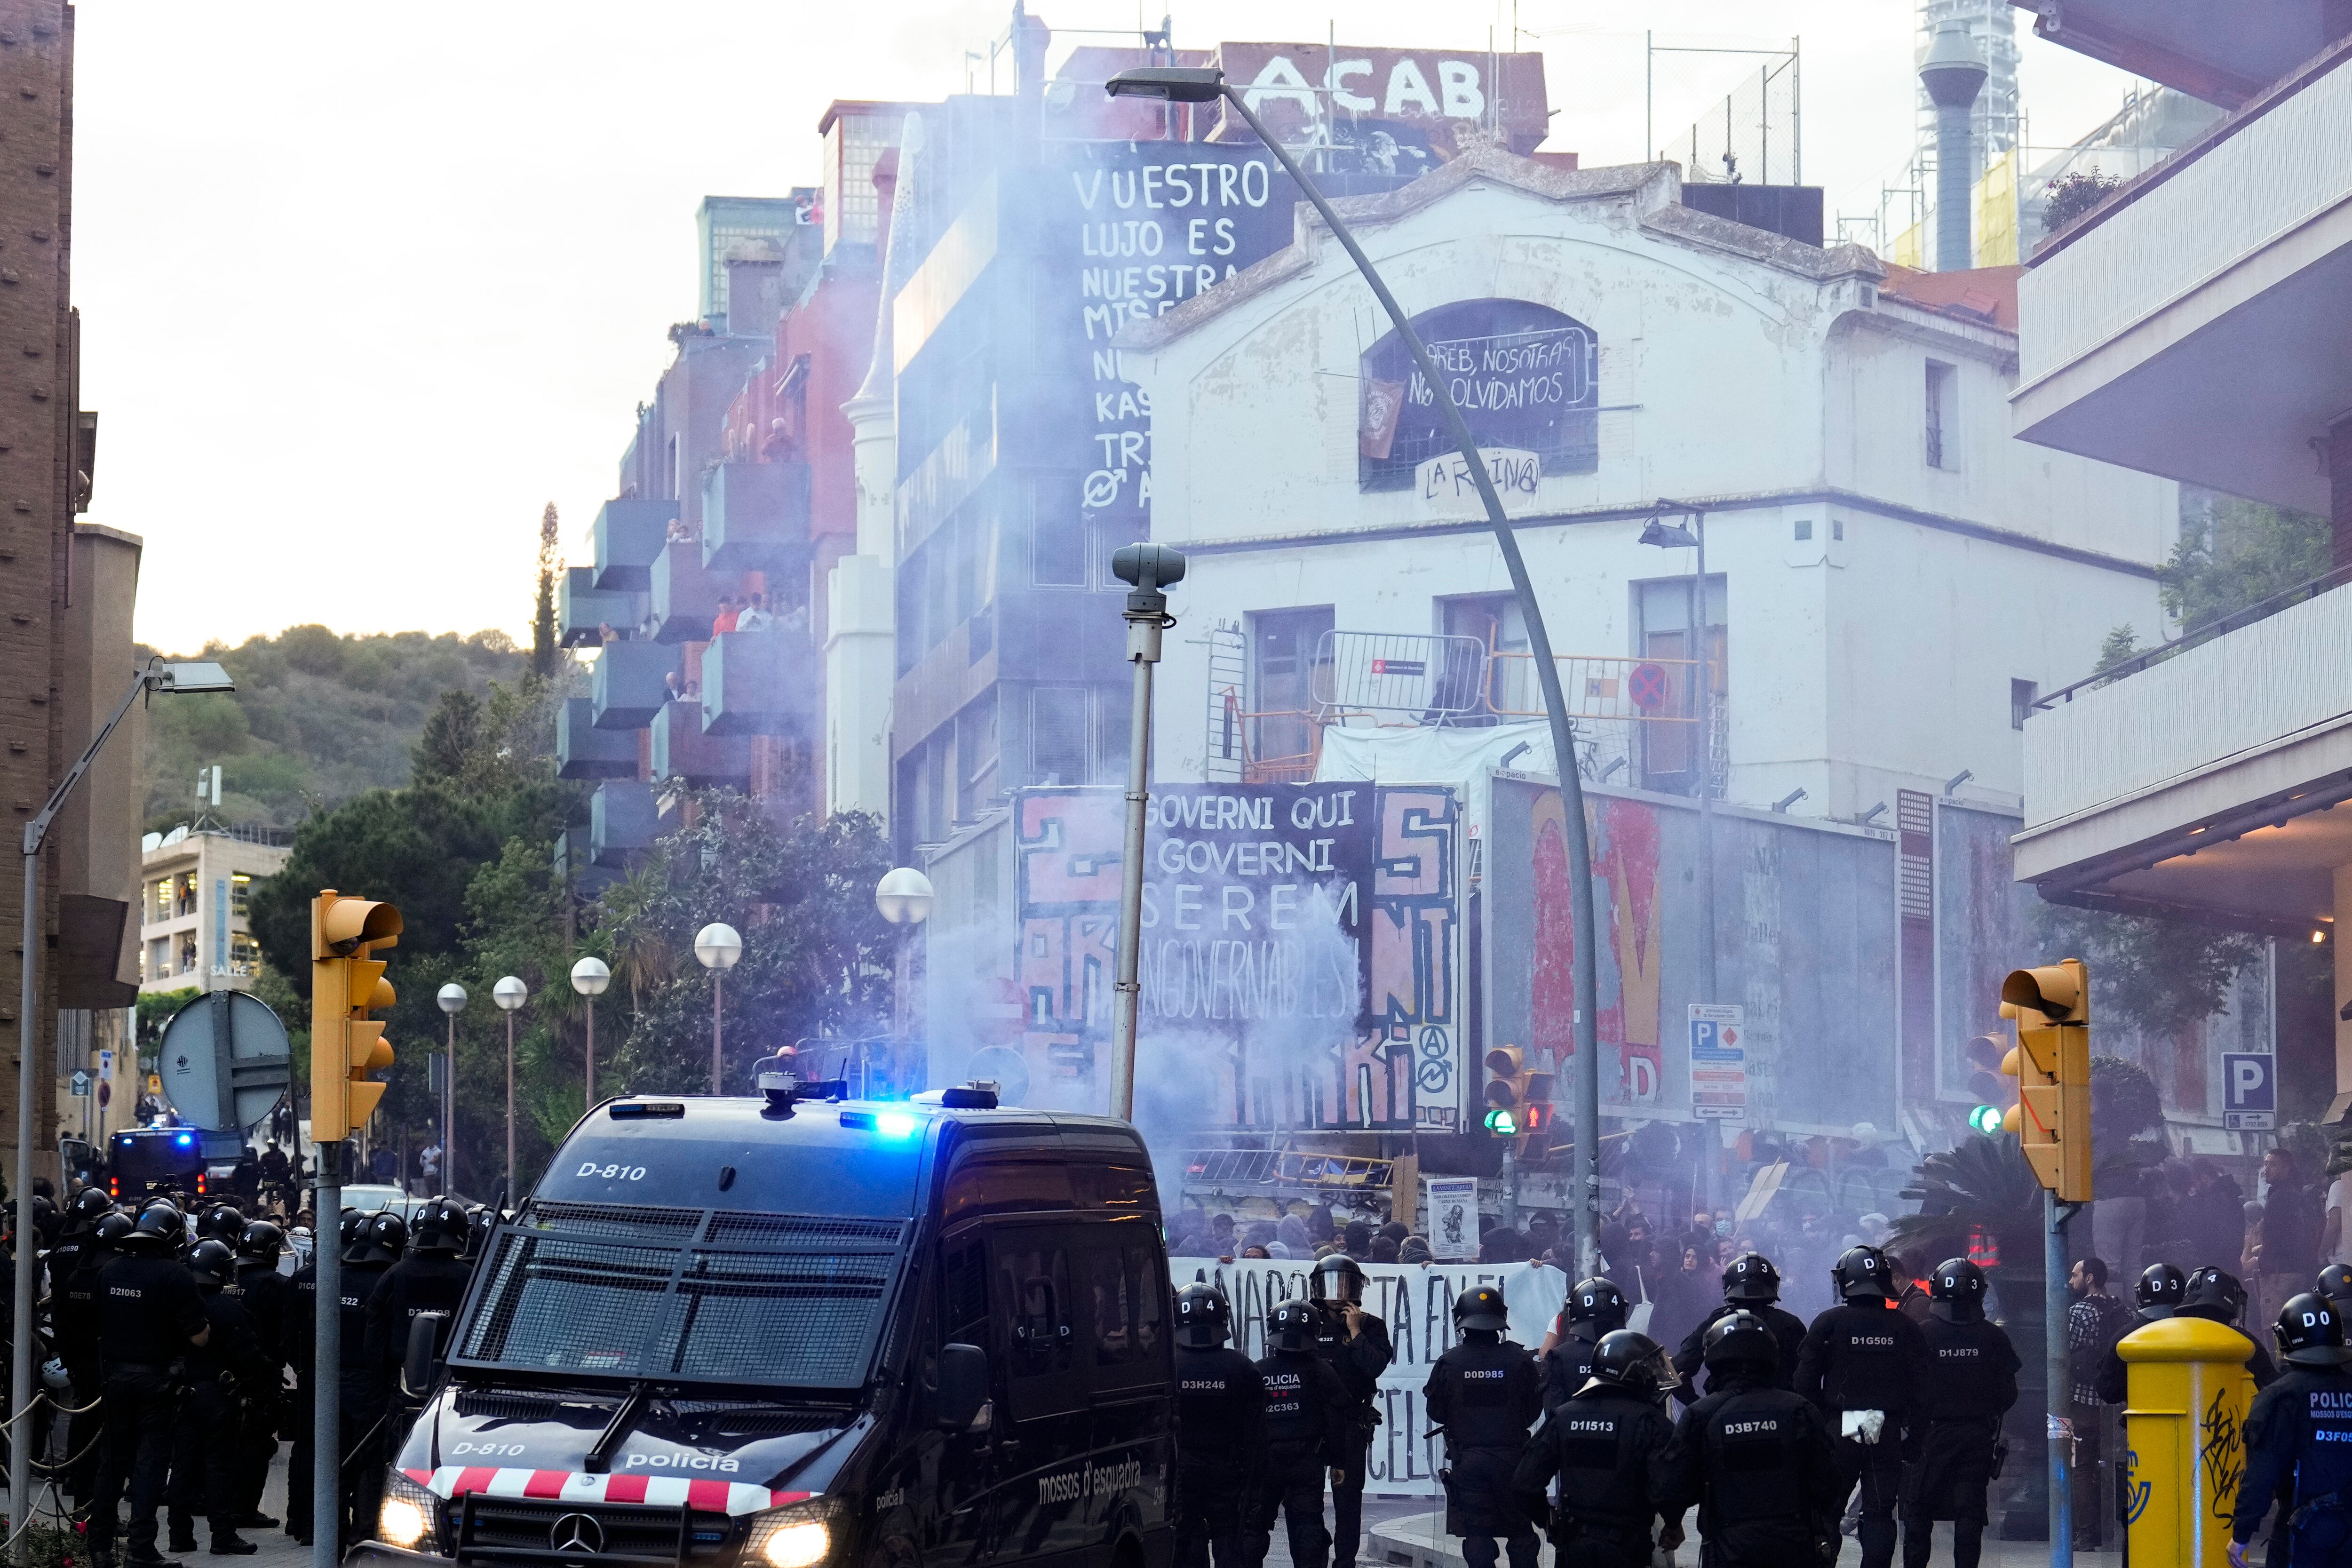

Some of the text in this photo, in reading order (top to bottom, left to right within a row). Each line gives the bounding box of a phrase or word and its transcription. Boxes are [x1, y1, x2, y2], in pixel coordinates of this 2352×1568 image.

[1243, 56, 1486, 119] ACAB
[1072, 160, 1269, 210] VUESTRO
[1083, 218, 1236, 257] LUJO ES
[1146, 790, 1356, 829] GOVERNI QUI
[1158, 838, 1335, 875] GOVERNI
[1140, 881, 1358, 931] SEREM
[210, 965, 247, 977] SALLE
[1698, 1023, 1712, 1046] P
[2234, 1060, 2264, 1104] P
[576, 1162, 647, 1181] D-810
[78, 1201, 85, 1209] 4
[417, 1209, 449, 1220] D 4
[378, 1221, 387, 1231] 4
[482, 1218, 490, 1227] 4
[96, 1227, 104, 1237] 4
[244, 1233, 252, 1242] 4
[192, 1249, 201, 1258] 4
[1737, 1262, 1768, 1273] D 3
[1863, 1258, 1875, 1270] D
[1945, 1277, 1978, 1289] D 3
[2207, 1274, 2217, 1283] 4
[2152, 1279, 2177, 1292] D 3
[1181, 1300, 1214, 1314] D 4
[1584, 1295, 1618, 1307] D 4
[1278, 1310, 1309, 1323] D 3
[2302, 1311, 2330, 1328] D 0
[1851, 1337, 1894, 1345] D1G505
[1603, 1343, 1611, 1357] 1
[1939, 1348, 1979, 1357] D1J879
[1464, 1370, 1504, 1379] D0D985
[1182, 1381, 1225, 1390] D3H246
[1265, 1402, 1299, 1413] 2C363
[1570, 1420, 1614, 1432] D1I513
[1725, 1420, 1777, 1435] D3B740
[451, 1441, 740, 1473] D-810 policia
[1039, 1452, 1141, 1505] mossos d'esquadra
